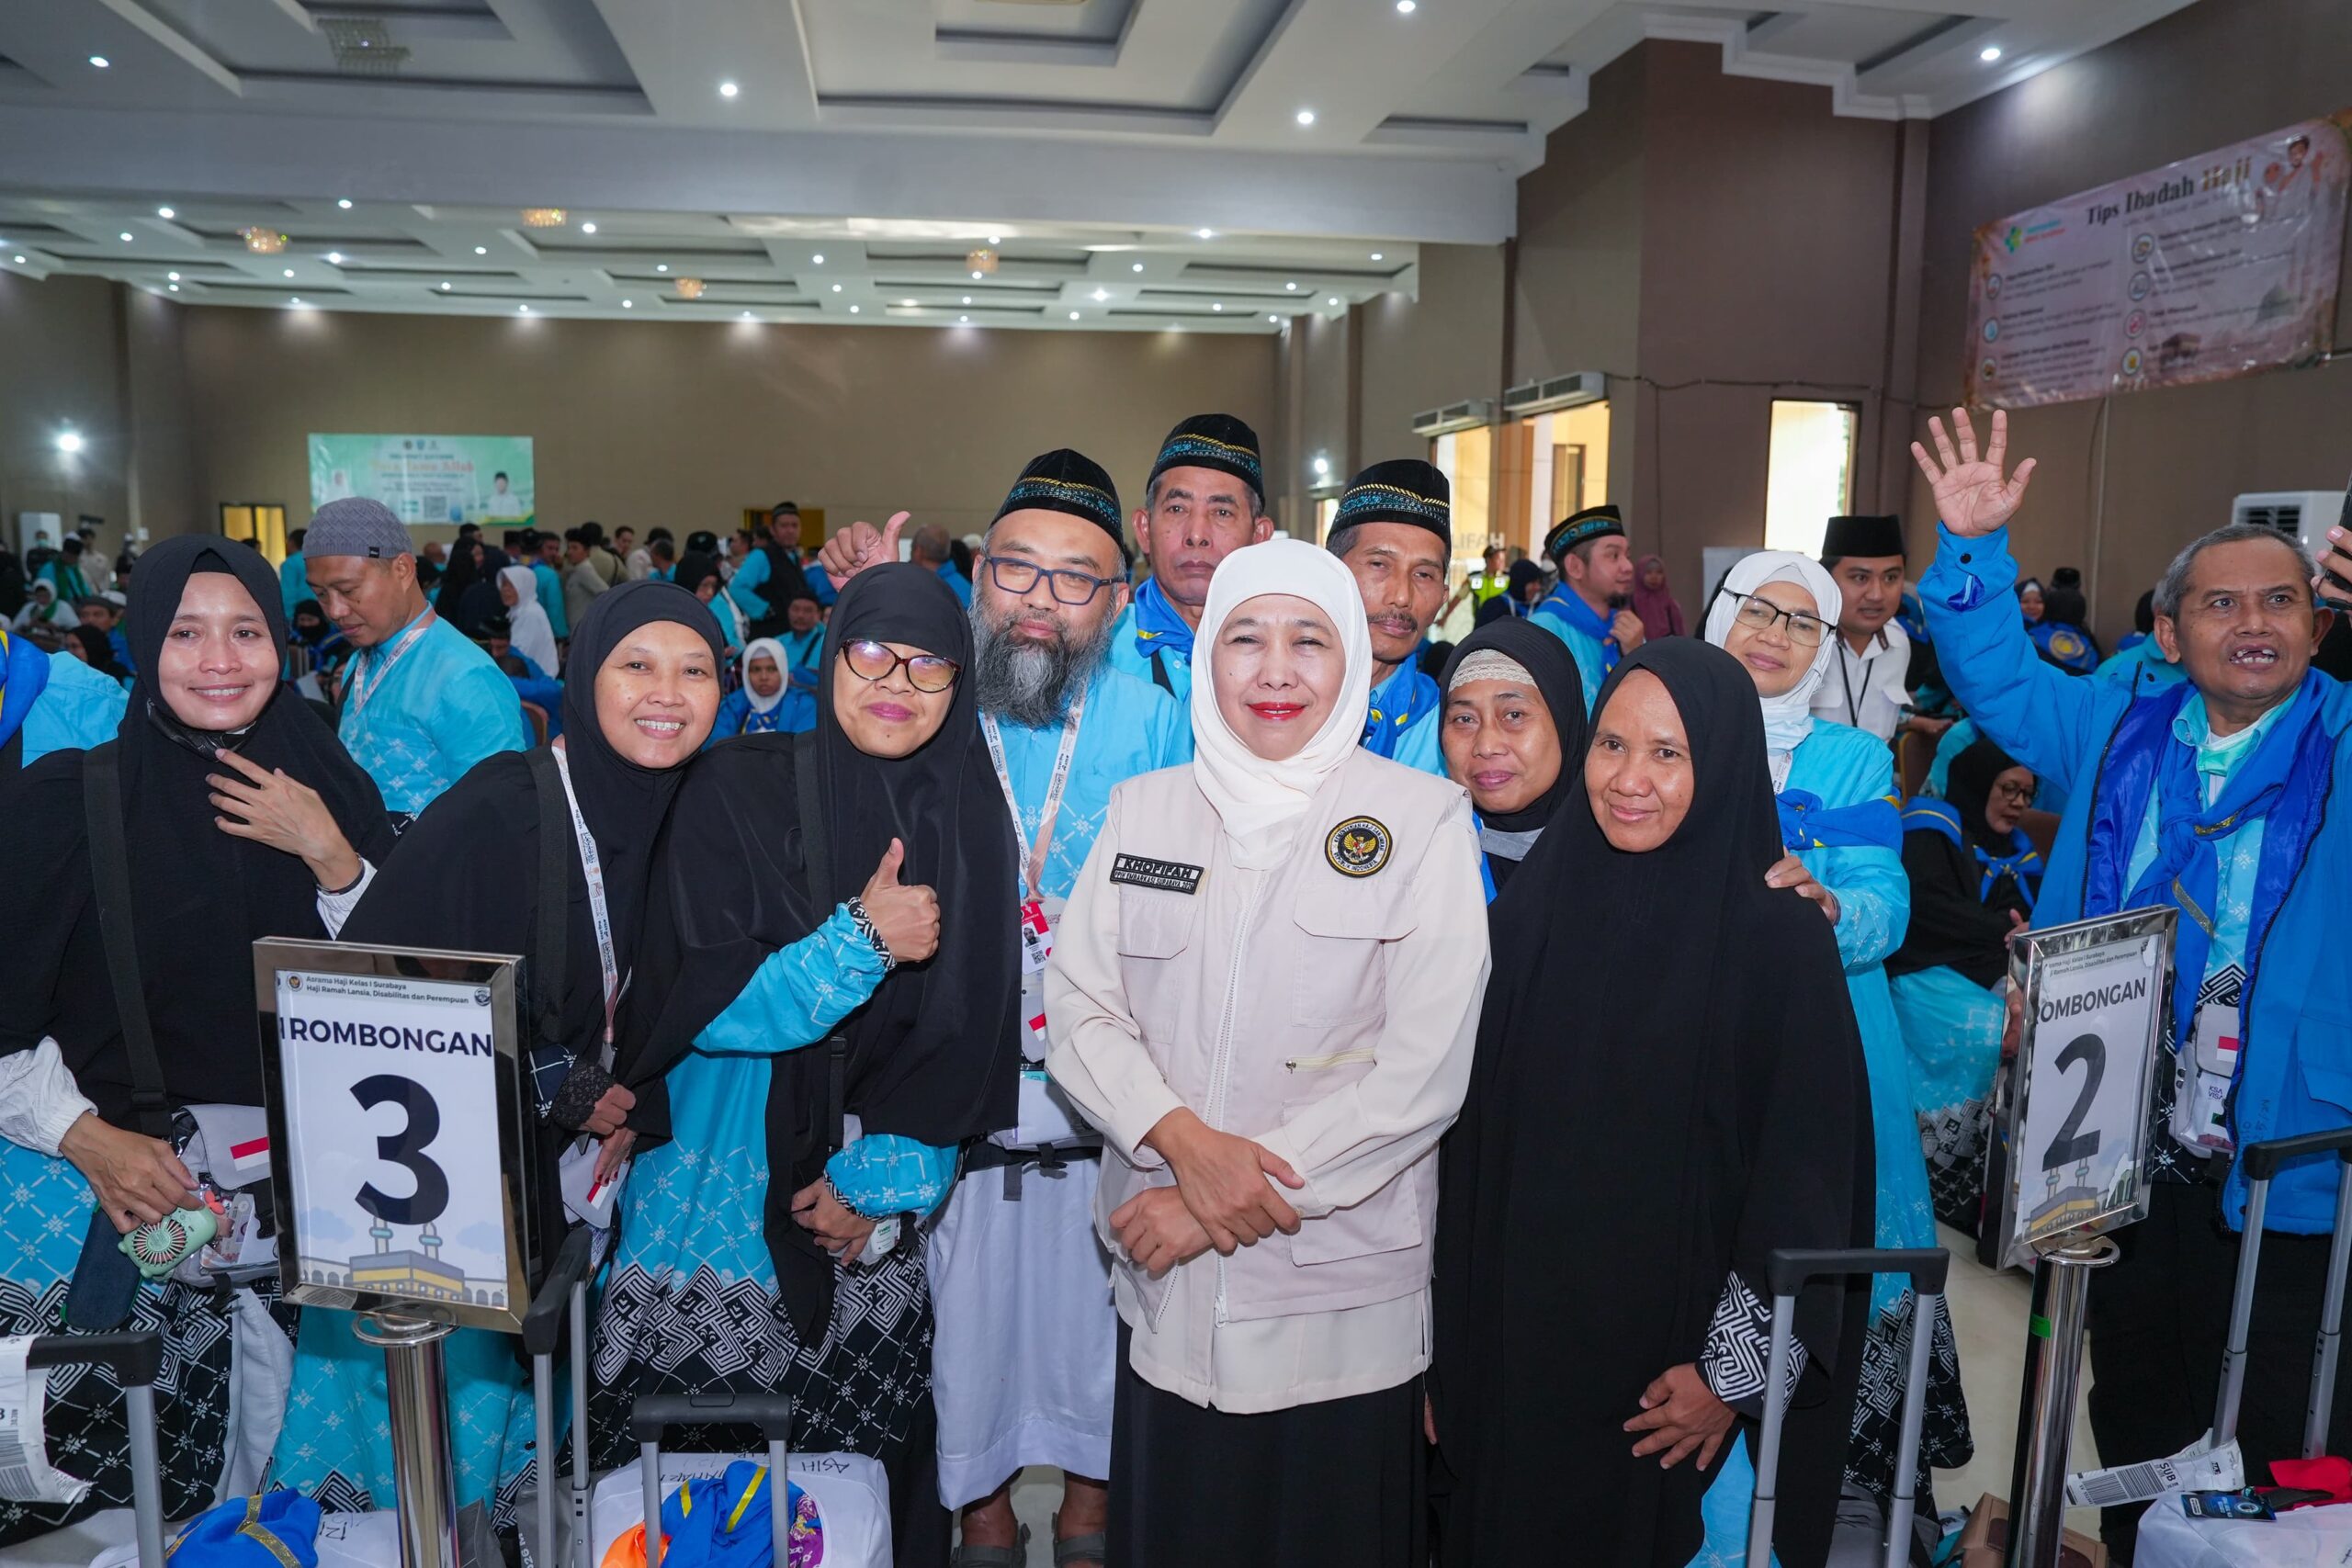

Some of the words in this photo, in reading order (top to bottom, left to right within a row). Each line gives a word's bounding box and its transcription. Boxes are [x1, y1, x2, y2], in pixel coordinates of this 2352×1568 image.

[2086, 203, 2120, 226] Tips
[2125, 175, 2195, 214] Ibadah
[1125, 859, 1192, 878] KHOFIFAH
[1126, 872, 1157, 885] EMBARKASI
[1157, 876, 1181, 888] SURABAYA
[2085, 958, 2106, 968] Disabilitas
[2114, 951, 2137, 960] Perempuan
[2086, 951, 2105, 960] Surabaya
[306, 976, 333, 985] Asrama
[334, 977, 348, 987] Haji
[349, 978, 368, 987] Kelas
[373, 981, 407, 990] Surabaya
[306, 985, 321, 994] Haji
[322, 987, 346, 995] Ramah
[347, 988, 372, 998] Lansia,
[373, 990, 411, 1000] Disabilitas
[426, 995, 469, 1005] Perempuan
[289, 1017, 492, 1057] ROMBONGAN
[2209, 1086, 2222, 1095] KSA
[2042, 1032, 2107, 1172] 2
[349, 1074, 450, 1225] 3
[801, 1457, 850, 1473] ASIH
[2159, 1462, 2177, 1482] SUB
